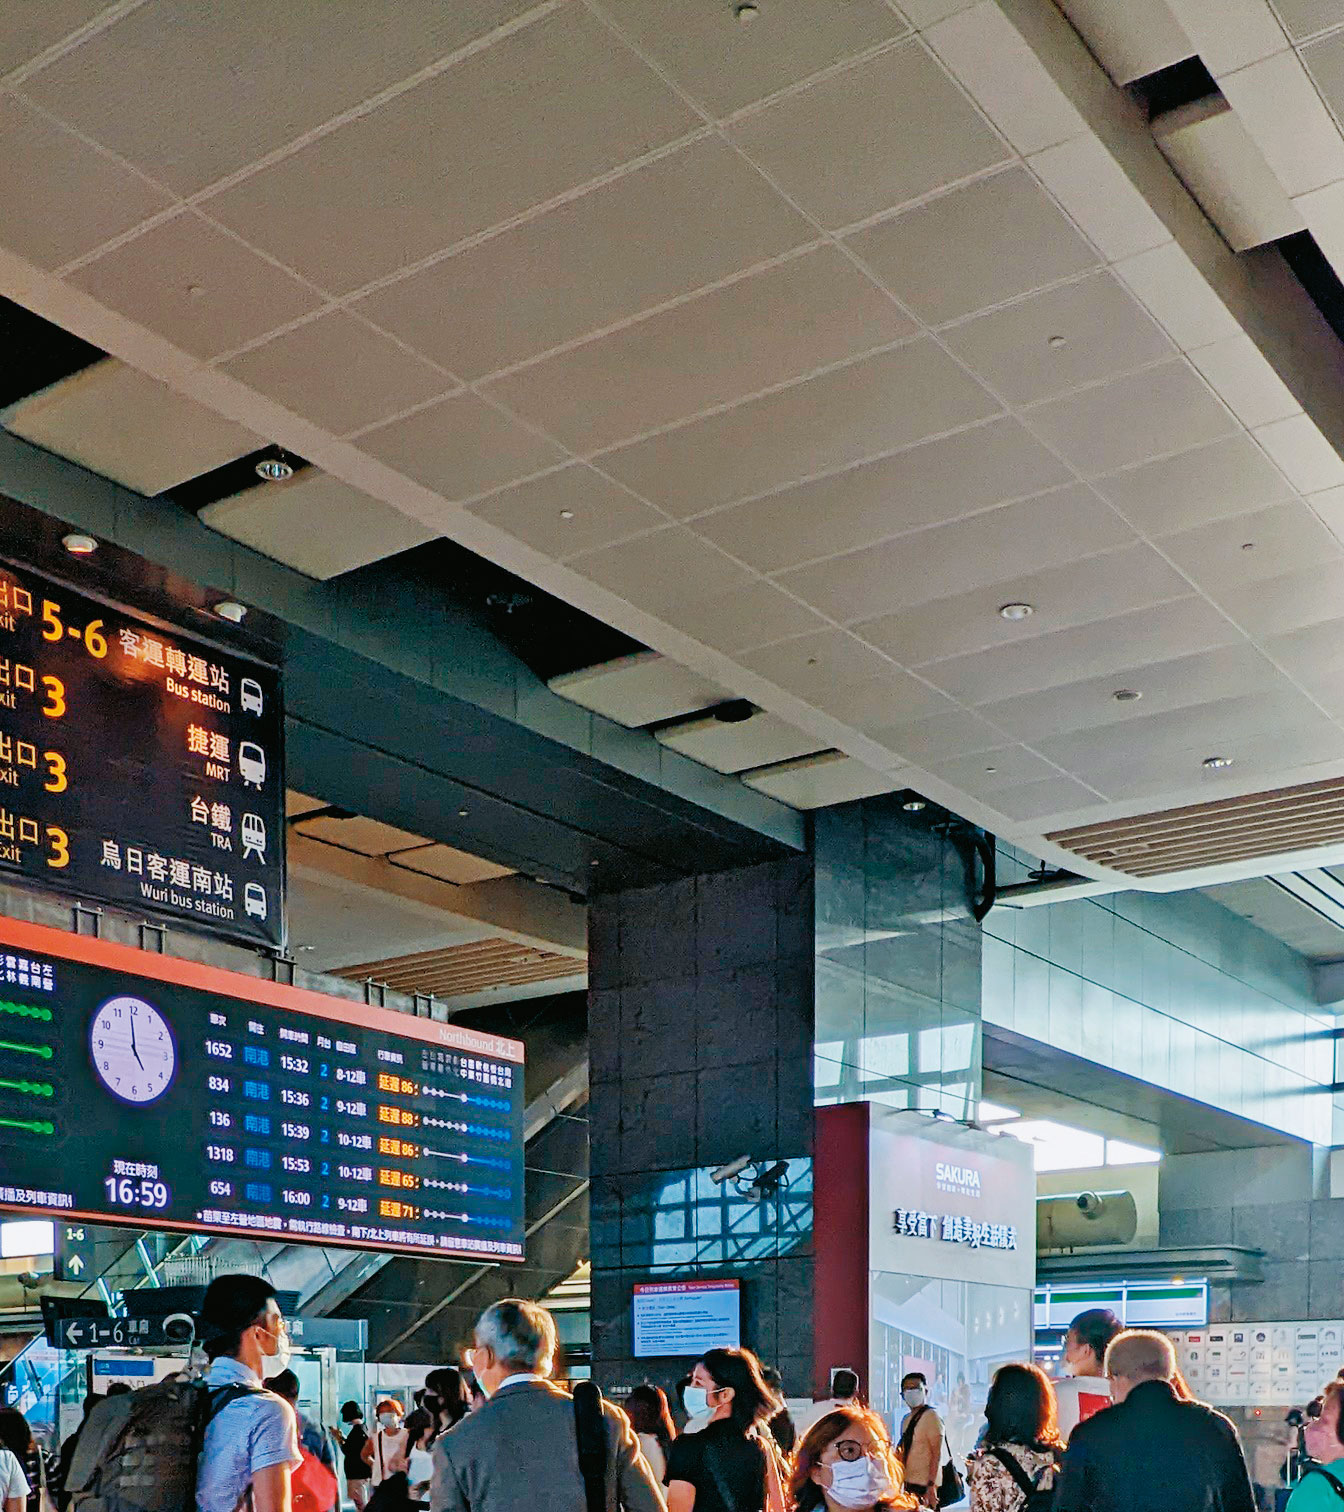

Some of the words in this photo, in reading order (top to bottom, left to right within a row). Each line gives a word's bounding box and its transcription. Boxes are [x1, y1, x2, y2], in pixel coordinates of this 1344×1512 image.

[43, 598, 107, 660] 5-6
[118, 629, 230, 695] 客運轉運站
[41, 676, 67, 717] 3
[166, 676, 190, 700] Bus
[192, 685, 231, 714] station
[187, 724, 230, 762] 捷運
[43, 752, 68, 793] 3
[205, 762, 231, 782] MRT
[191, 795, 232, 833] 台鐵
[46, 827, 70, 869] 3
[210, 833, 232, 852] TRA
[100, 840, 234, 902] 烏日客運南站
[140, 881, 169, 906] Wuri
[170, 889, 192, 909] bus
[194, 894, 234, 921] station
[113, 1008, 122, 1018] 11
[129, 1005, 138, 1015] 12
[102, 1020, 111, 1030] 10
[147, 1015, 152, 1024] 1
[98, 1039, 104, 1049] 9
[158, 1031, 164, 1041] 2
[439, 1029, 494, 1052] Northbound
[496, 1040, 516, 1058] 北上
[163, 1051, 168, 1061] 3
[206, 1040, 232, 1059] 1652
[244, 1046, 270, 1067] 南港
[103, 1061, 109, 1071] 8
[280, 1055, 309, 1074] 15:32
[320, 1063, 328, 1077] 2
[115, 1077, 121, 1086] 7
[158, 1071, 163, 1080] 4
[336, 1068, 367, 1085] 8-12車
[131, 1085, 138, 1095] 6
[147, 1083, 153, 1093] 5
[208, 1076, 230, 1093] 834
[244, 1081, 270, 1101] 南港
[401, 1080, 414, 1094] 86
[281, 1089, 310, 1107] 15:36
[320, 1096, 329, 1110] 2
[336, 1100, 367, 1117] 9-12車
[209, 1110, 231, 1127] 136
[245, 1115, 271, 1134] 南港
[281, 1122, 310, 1140] 15:39
[320, 1129, 329, 1143] 2
[337, 1133, 373, 1150] 10-12車
[401, 1143, 415, 1157] 86
[207, 1145, 234, 1163] 1318
[245, 1149, 271, 1168] 南港
[113, 1159, 158, 1179] 現在時刻
[281, 1156, 310, 1173] 15:53
[321, 1162, 329, 1176] 2
[337, 1165, 373, 1182] 10-12車
[402, 1174, 415, 1188] 65
[935, 1162, 981, 1189] SAKURA
[105, 1177, 168, 1208] 16:59
[210, 1180, 231, 1196] 654
[246, 1183, 272, 1203] 南港
[282, 1190, 311, 1206] 16:00
[321, 1194, 330, 1209] 2
[337, 1197, 368, 1213] 9-12車
[402, 1205, 414, 1219] 71
[66, 1227, 84, 1241] 1-6
[88, 1321, 124, 1344] 1-6
